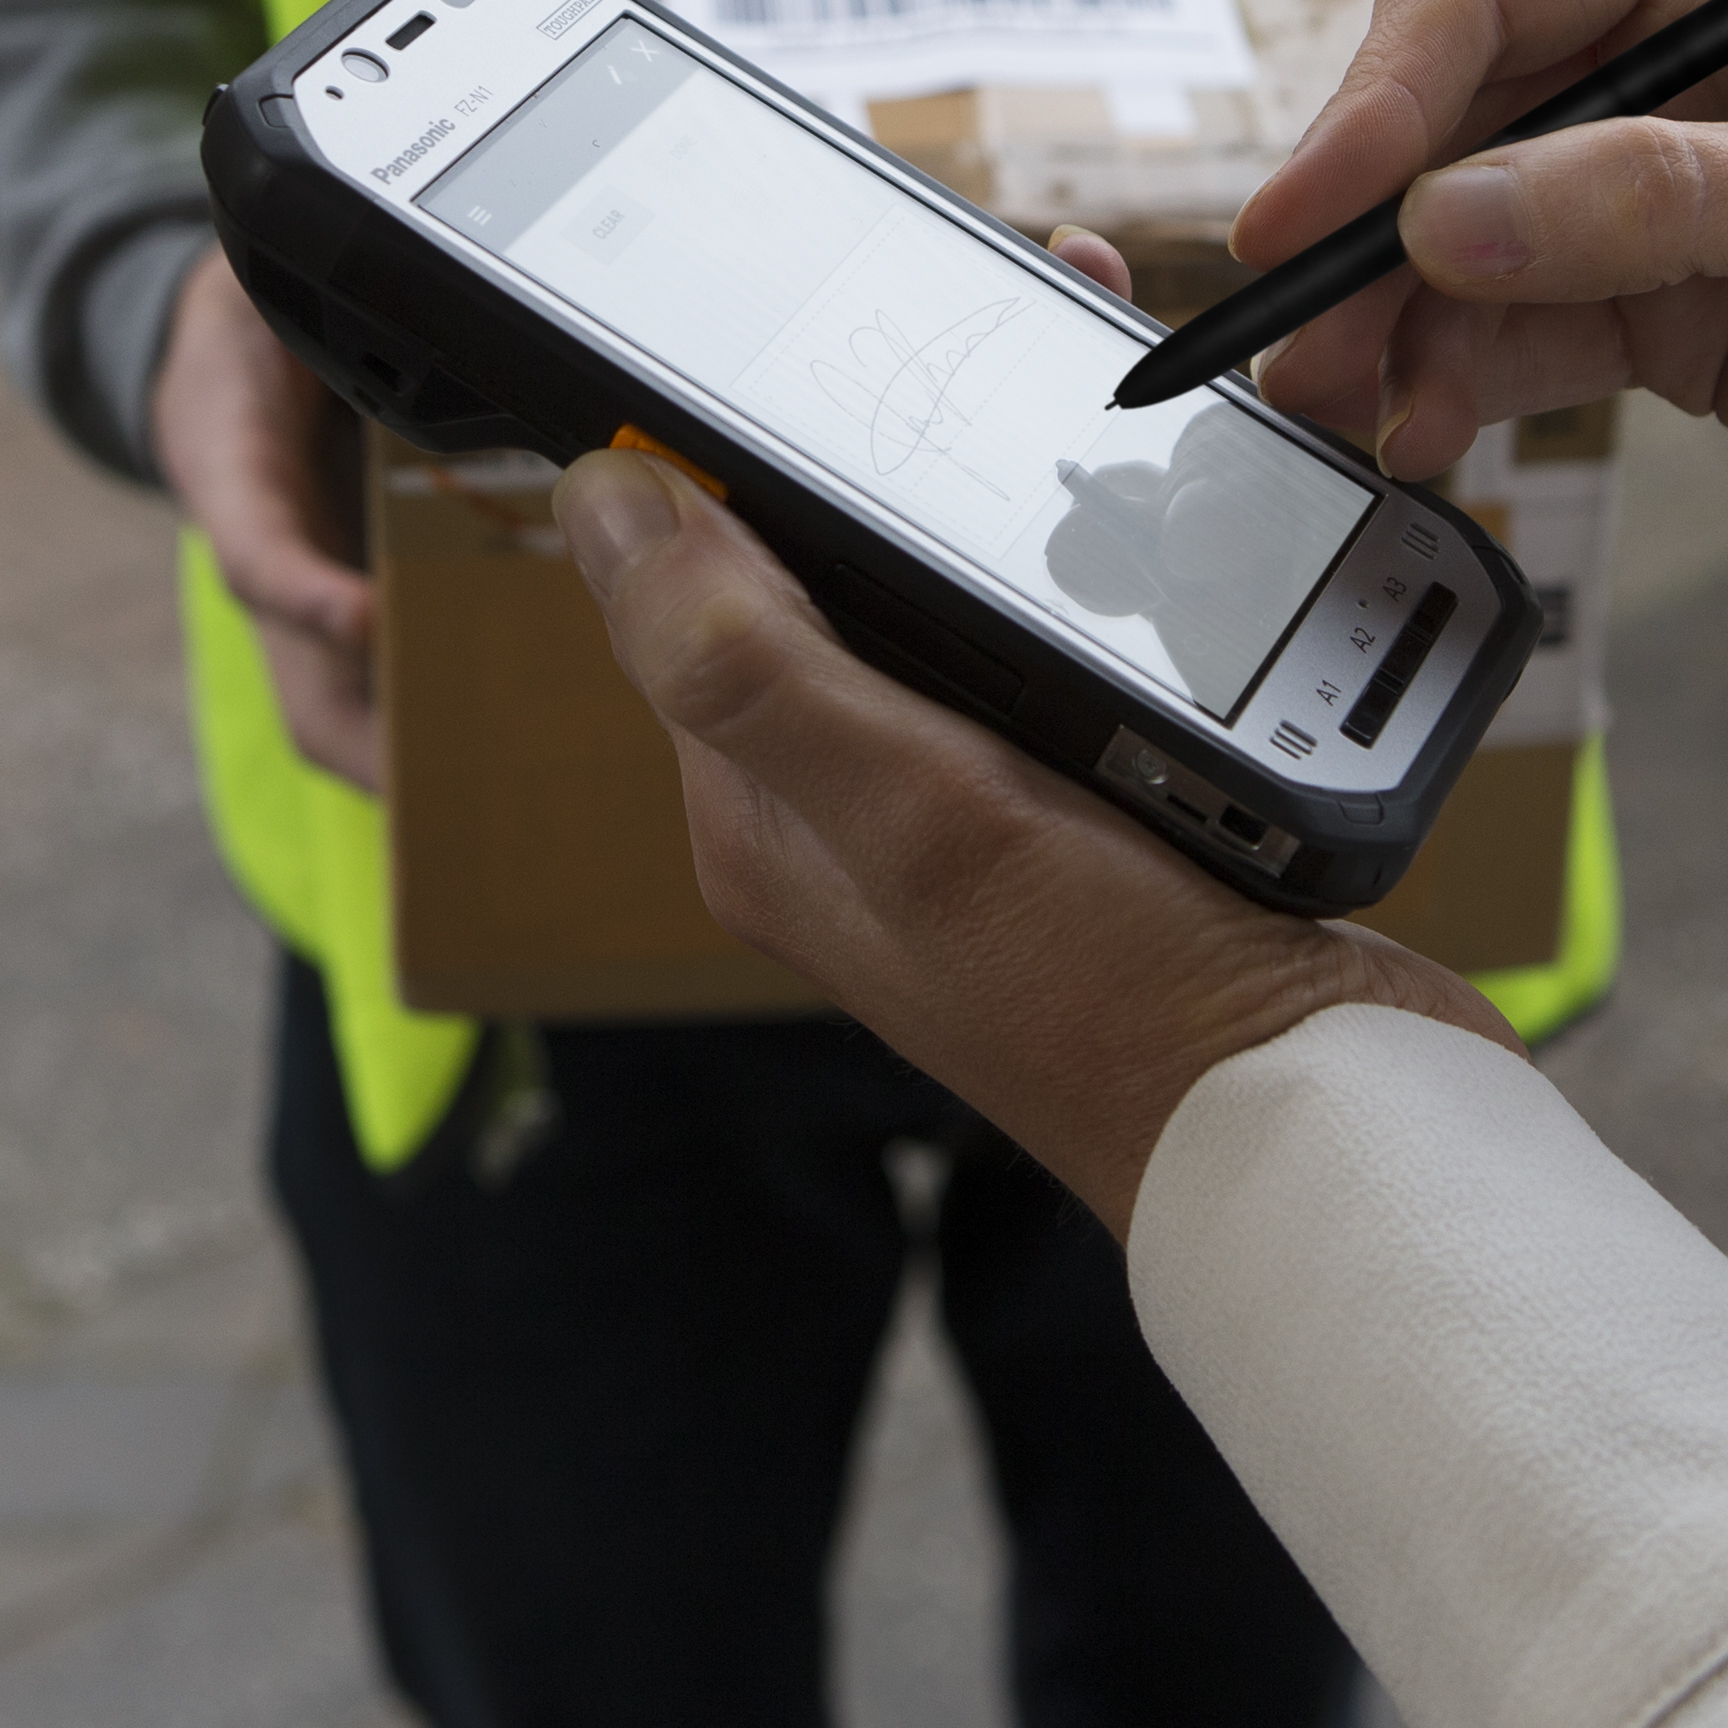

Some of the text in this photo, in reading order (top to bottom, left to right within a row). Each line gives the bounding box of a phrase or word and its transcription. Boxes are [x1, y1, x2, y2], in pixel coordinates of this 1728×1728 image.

[370, 85, 494, 185] Panasonic FZ-N1
[592, 209, 627, 240] CLEAR
[1316, 576, 1408, 707] A1 A2 A3
